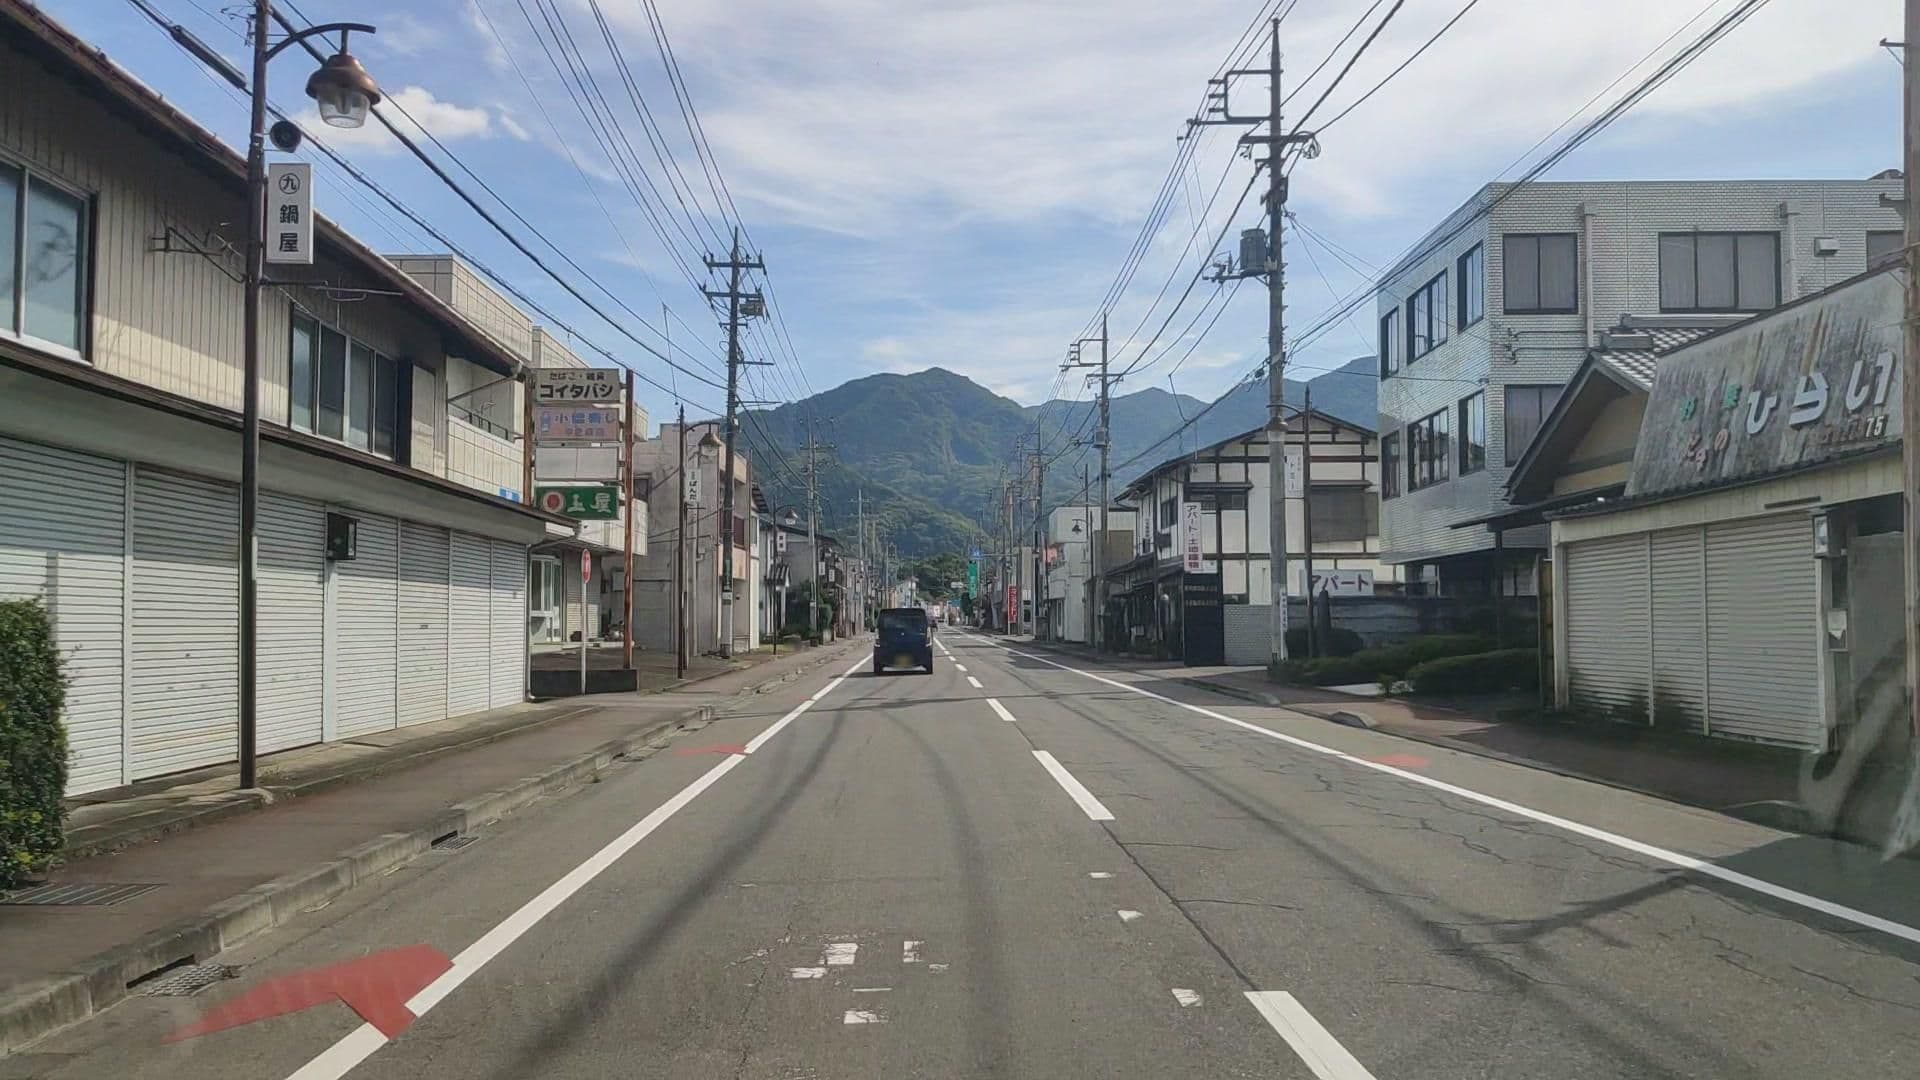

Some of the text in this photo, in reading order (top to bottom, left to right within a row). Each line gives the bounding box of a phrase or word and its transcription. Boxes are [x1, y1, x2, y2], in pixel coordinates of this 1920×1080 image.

[540, 383, 613, 398] コイタバシ
[1745, 351, 1896, 436] ひらい
[1865, 415, 1885, 438] 75
